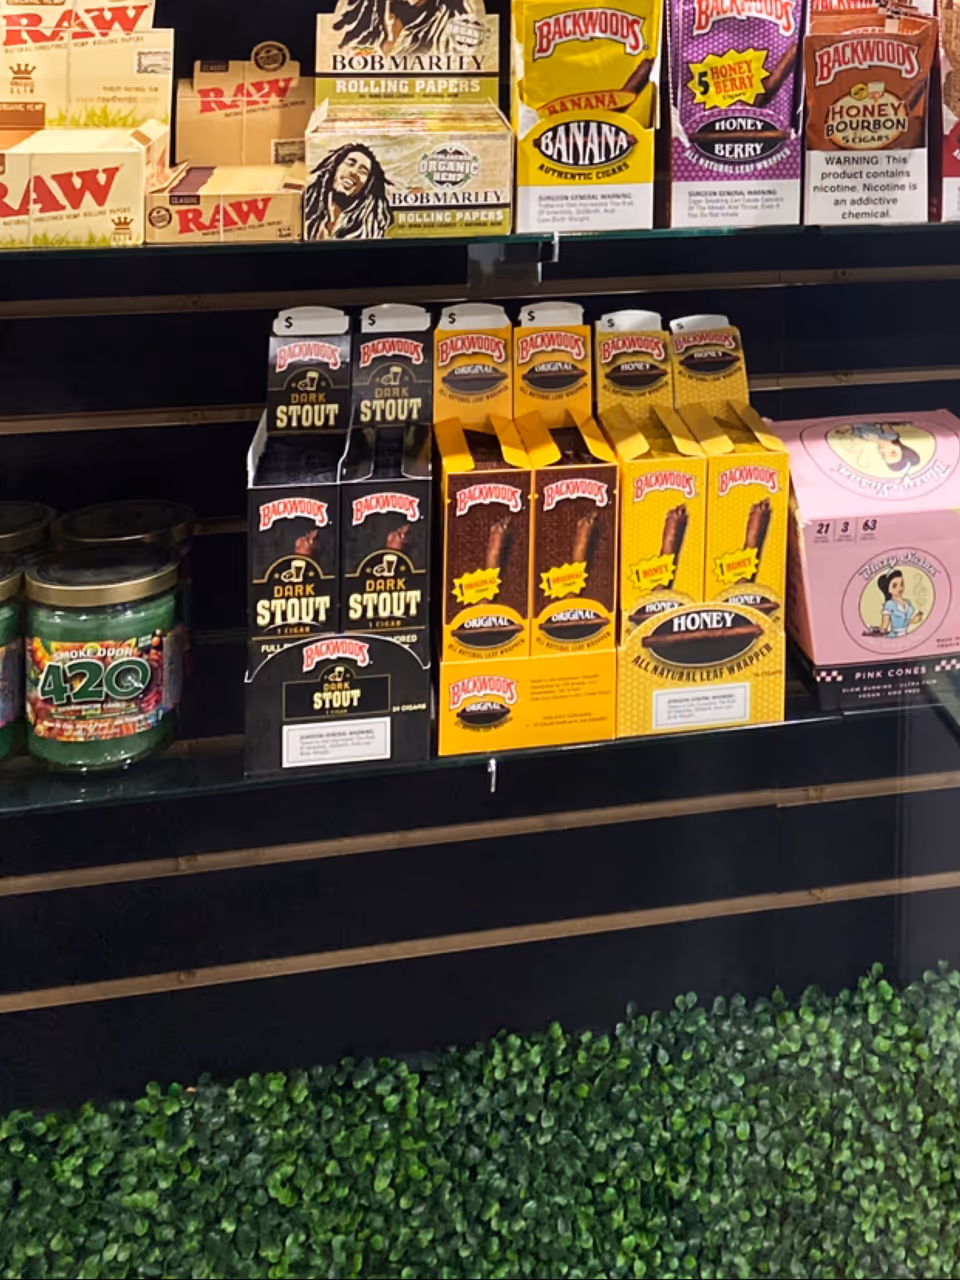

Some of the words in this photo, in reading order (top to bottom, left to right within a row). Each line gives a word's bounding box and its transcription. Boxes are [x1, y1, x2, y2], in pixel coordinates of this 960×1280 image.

[2, 4, 149, 46] RAW
[534, 8, 645, 58] BACKWOODS
[332, 55, 385, 71] BOB
[815, 37, 919, 86] BACKWOODS
[335, 80, 409, 94] ROLLING
[415, 80, 481, 93] PAPERS
[697, 70, 710, 95] 5
[710, 60, 753, 79] HONEY
[713, 74, 755, 95] BERRY
[197, 77, 294, 114] RAW
[829, 102, 903, 119] HONEY
[715, 119, 764, 131] HONEY
[825, 118, 907, 138] BOURBON
[541, 122, 628, 165] BANANA
[714, 143, 764, 158] BERRY
[538, 163, 593, 181] AUTHENTIC
[595, 162, 630, 180] CIGARS
[885, 155, 908, 165] This
[820, 169, 862, 181] product
[865, 168, 911, 178] contains
[863, 181, 906, 192] Nicotine
[908, 181, 918, 191] is
[391, 192, 431, 204] BOB
[833, 197, 847, 206] an
[849, 195, 898, 206] addictive
[175, 197, 272, 235] RAW
[398, 212, 452, 223] ROLLING
[455, 211, 504, 222] PAPERS
[360, 338, 424, 368] BACKWOODS
[438, 334, 506, 367] BACKWOODS
[518, 331, 584, 365] BACKWOODS
[601, 336, 665, 364] BACKWOODS
[673, 332, 736, 354] BACKWOODS
[276, 342, 342, 373] BACKWOODS
[291, 393, 326, 404] DARK
[375, 387, 409, 398] DARK
[276, 404, 339, 428] STOUT
[360, 398, 422, 422] STOUT
[633, 471, 695, 503] BACKWOODS
[718, 466, 779, 497] BACKWOODS
[456, 484, 522, 517] BACKWOODS
[543, 478, 608, 511] BACKWOODS
[260, 497, 329, 531] BACKWOODS
[352, 492, 420, 526] BACKWOODS
[817, 522, 830, 535] 21
[274, 584, 315, 598] DARK
[366, 578, 406, 592] DARK
[256, 596, 330, 626] STOUT
[349, 590, 421, 619] STOUT
[672, 611, 736, 633] HONEY
[303, 638, 369, 672] BACKWOODS
[631, 654, 651, 673] ALL
[652, 663, 698, 683] NATURAL
[699, 664, 725, 682] LEAF
[727, 643, 773, 675] WRAPPER
[855, 669, 882, 680] PINK
[888, 666, 927, 678] CONES
[313, 689, 361, 709] STOUT
[449, 676, 518, 711] BACKWOODS
